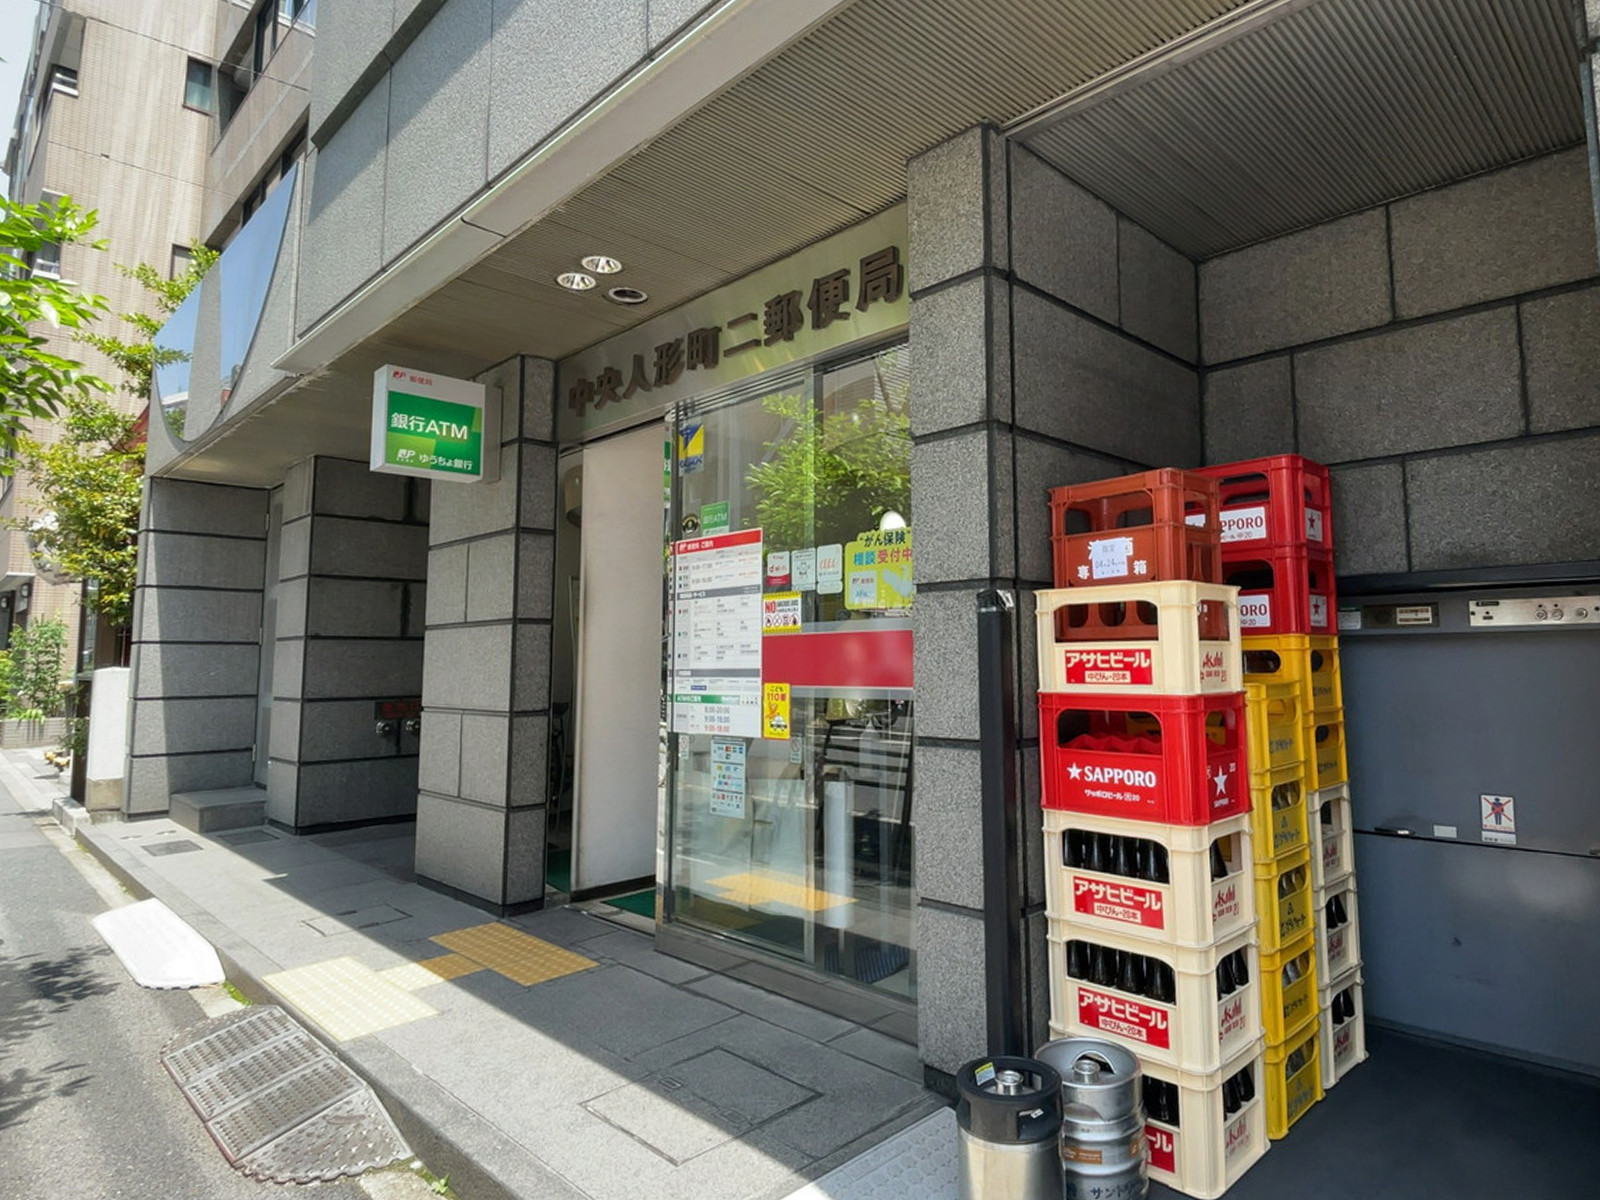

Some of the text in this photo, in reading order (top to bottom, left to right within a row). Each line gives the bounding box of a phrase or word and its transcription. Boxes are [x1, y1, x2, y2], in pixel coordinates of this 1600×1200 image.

[568, 245, 904, 417] 中央人形町二郵便局
[390, 412, 468, 440] 銀行ATM
[419, 454, 473, 470] ゆうちょ銀行
[1220, 515, 1263, 531] PPORO
[854, 547, 912, 566] 相談受付中
[1240, 604, 1268, 617] ORO
[1066, 652, 1150, 668] アサヒビール
[1203, 651, 1223, 668] Asahi
[1084, 766, 1156, 788] SAPPORO
[1075, 879, 1161, 910] アサヒビール
[1215, 884, 1235, 909] Asahi
[1080, 990, 1166, 1029] アサヒビール
[1221, 996, 1241, 1027] Asahi
[1146, 1132, 1172, 1152] ール
